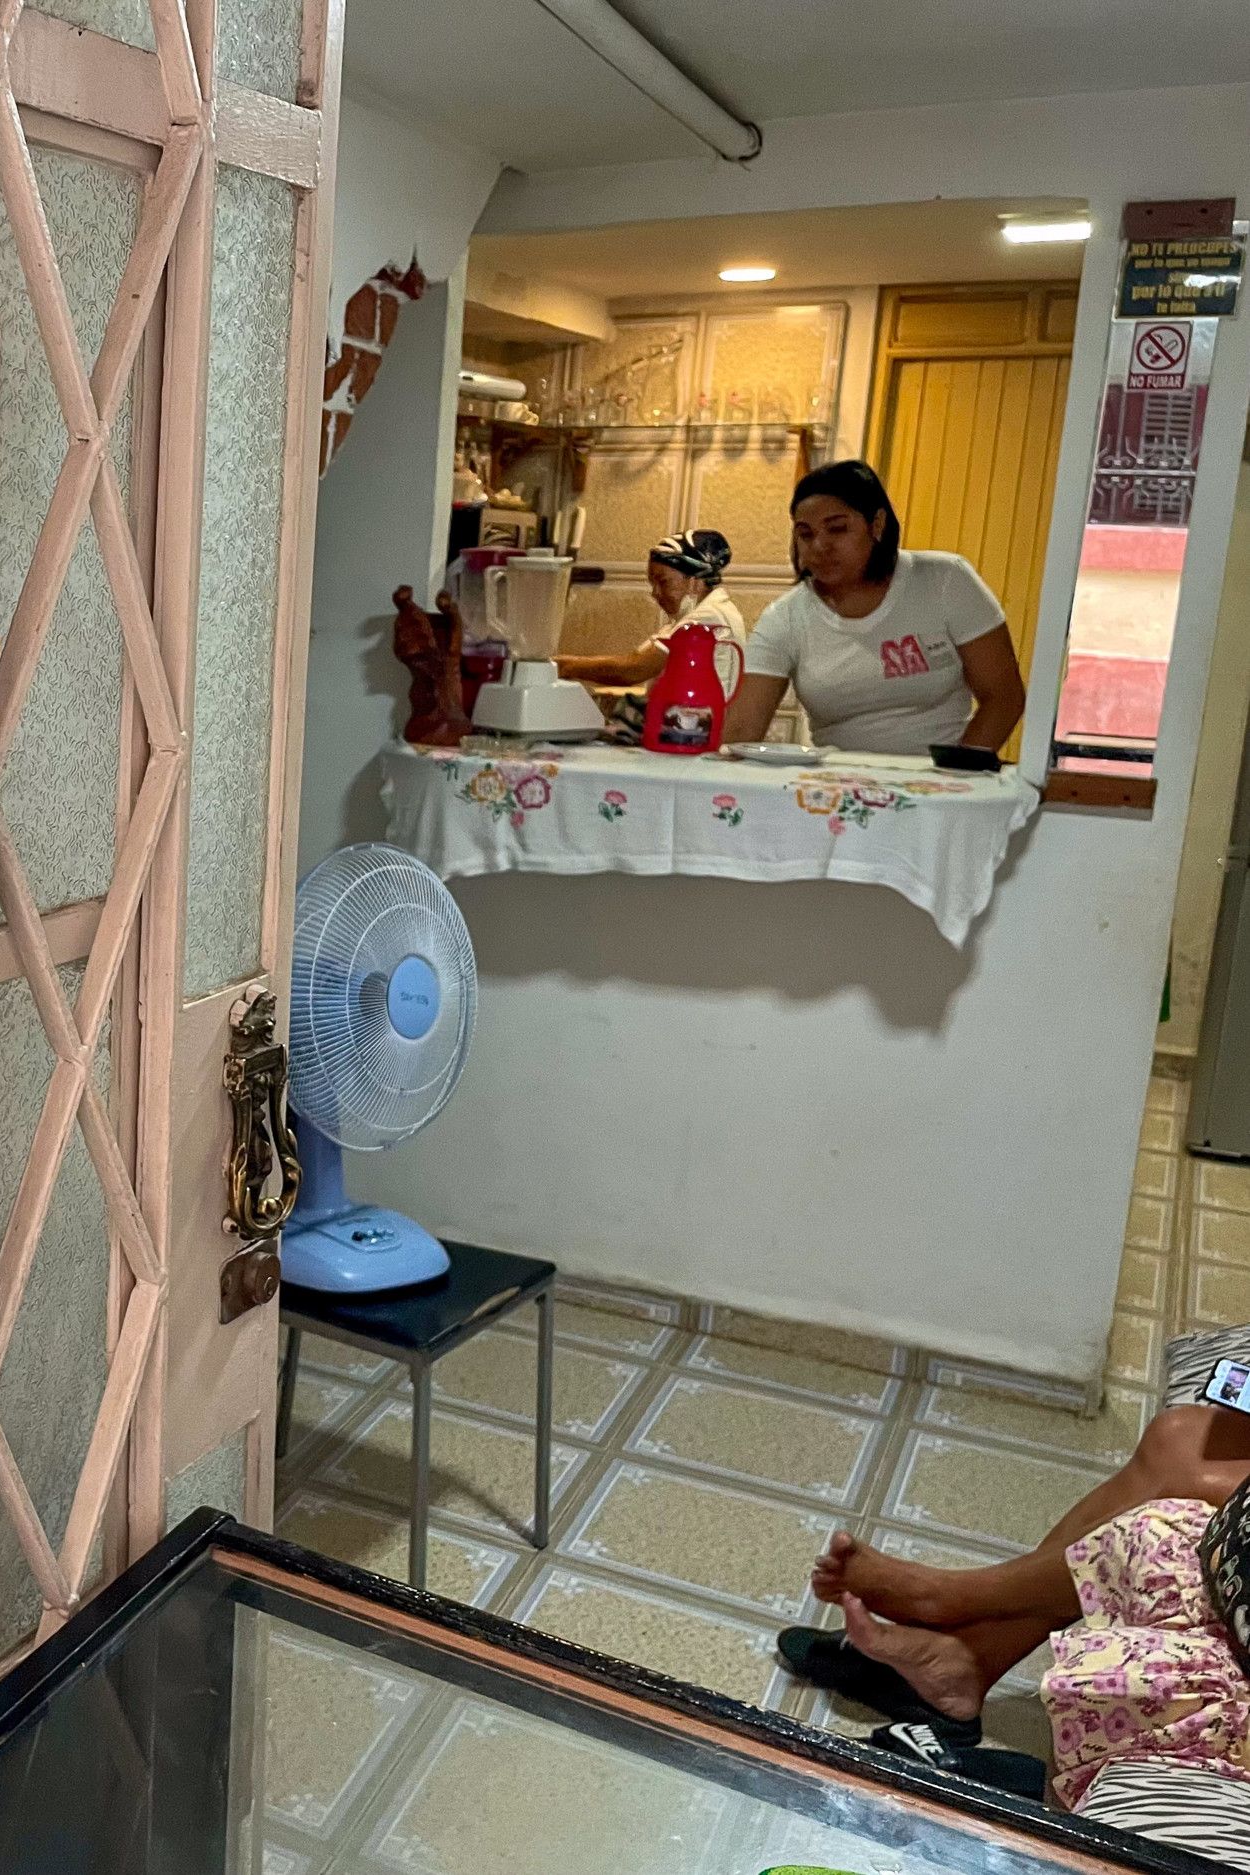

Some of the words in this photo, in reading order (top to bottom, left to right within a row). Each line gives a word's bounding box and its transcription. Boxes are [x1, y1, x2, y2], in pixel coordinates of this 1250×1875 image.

[1130, 375, 1145, 388] NO
[1147, 375, 1181, 388] FUMAR
[907, 1723, 945, 1755] NIKE
